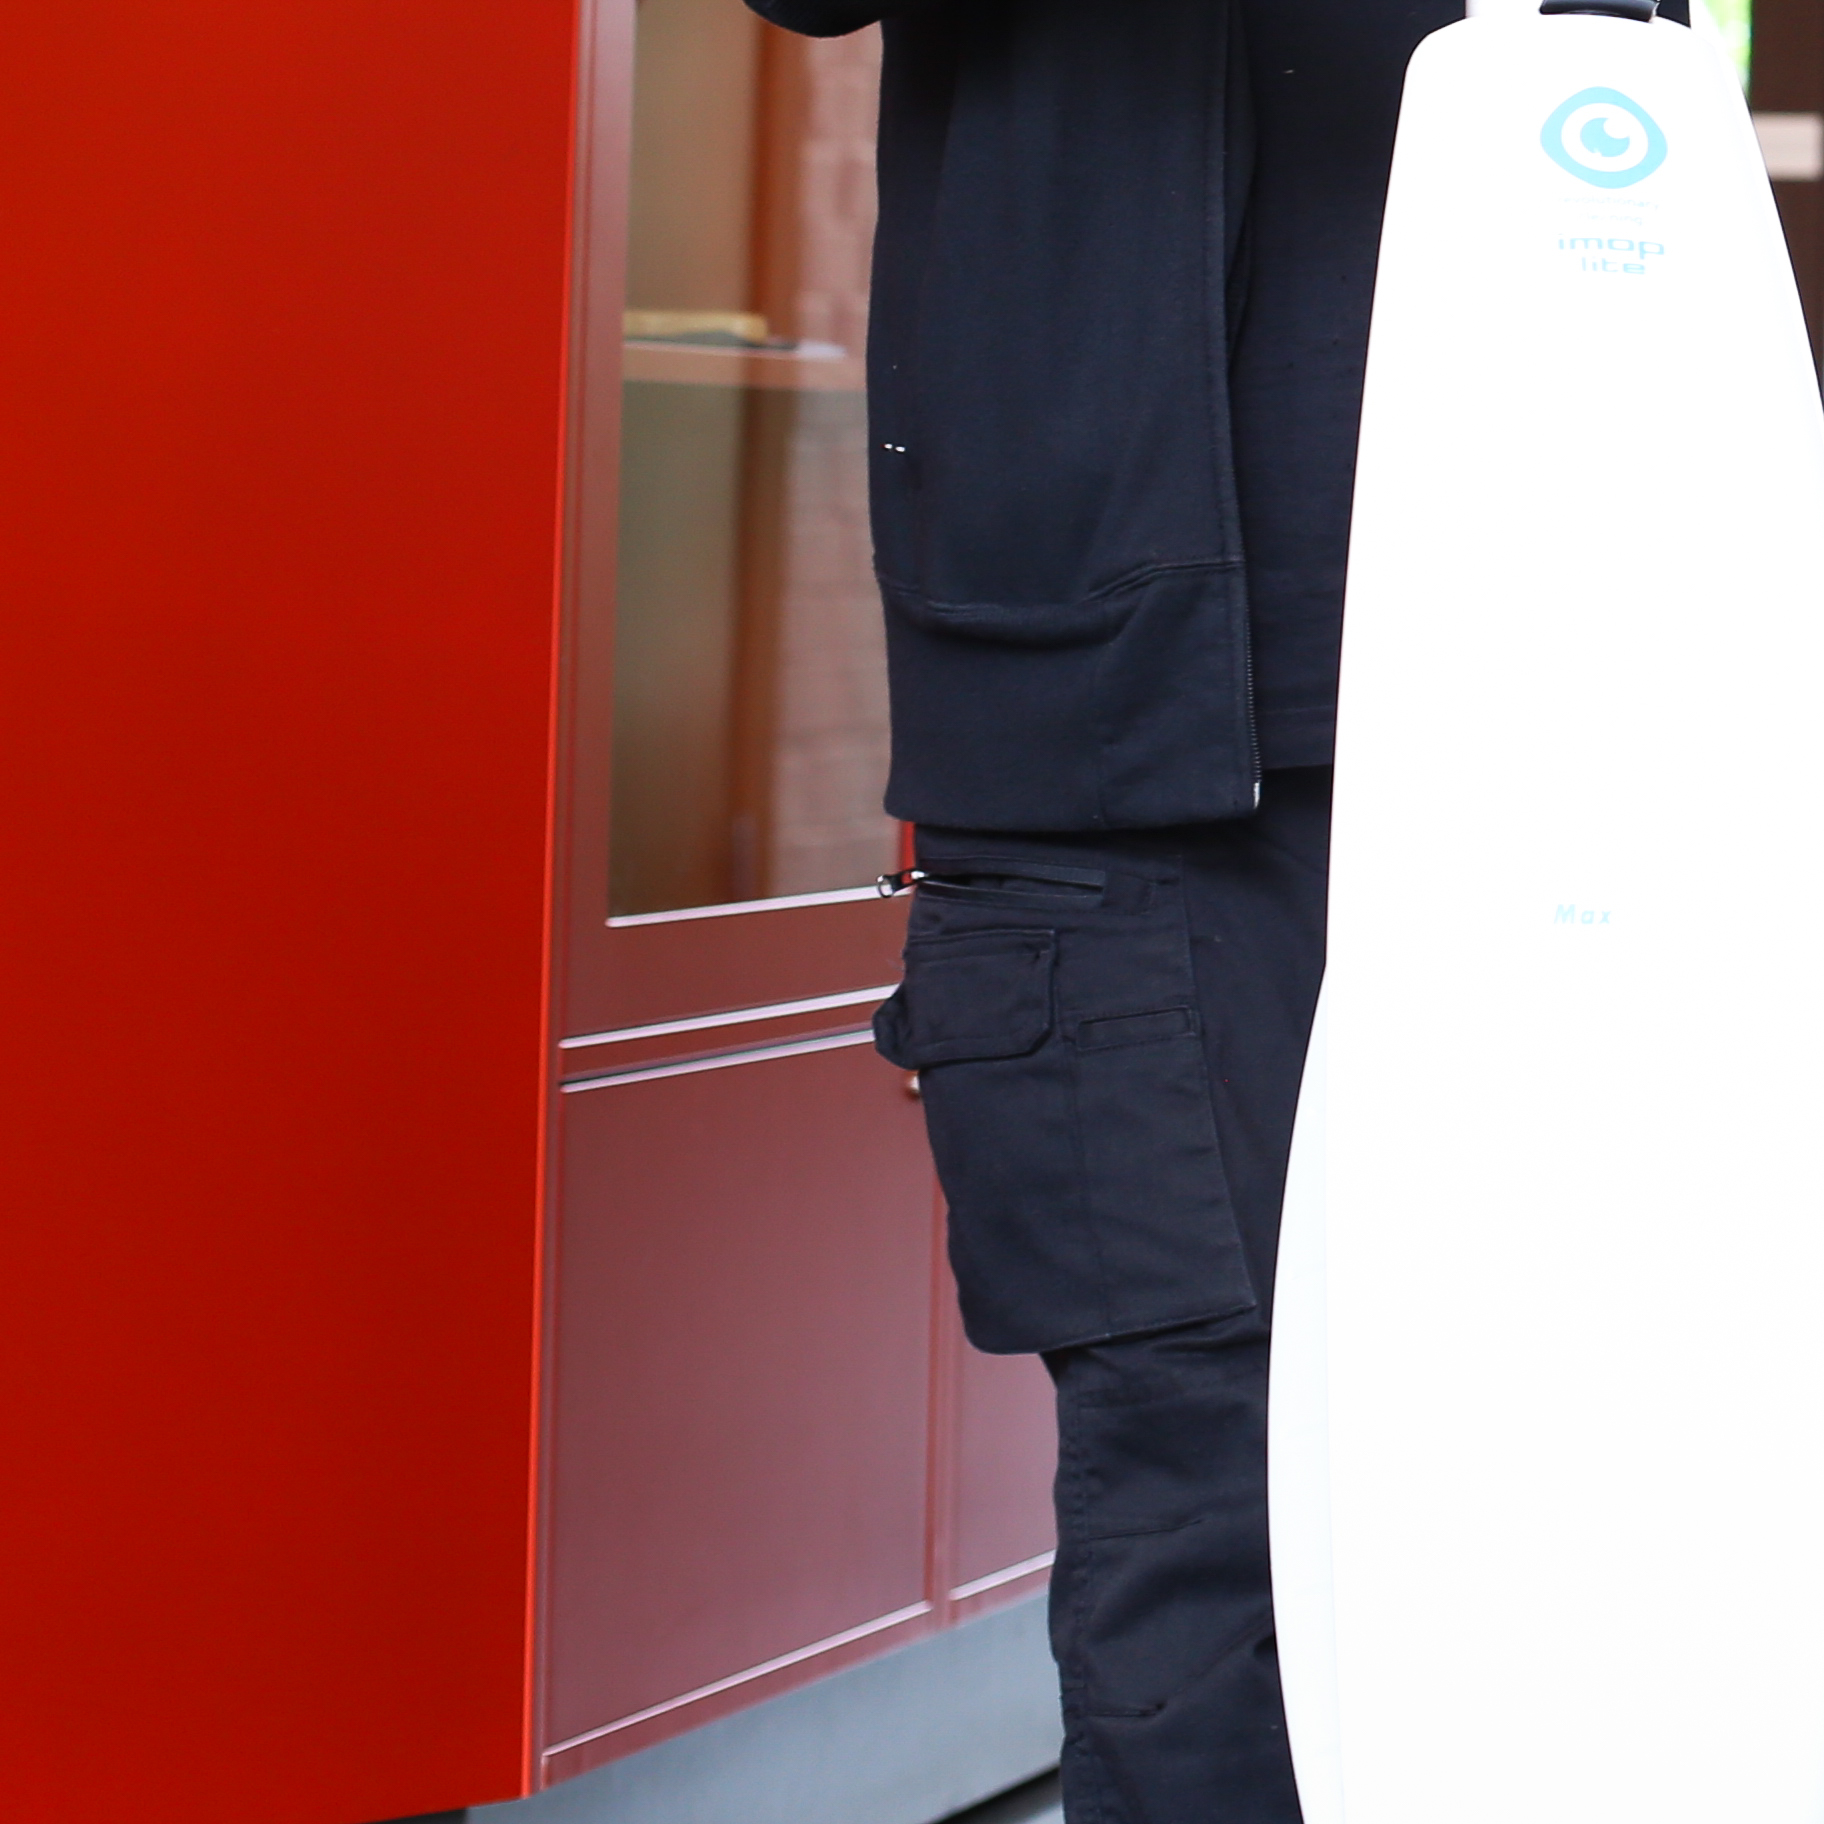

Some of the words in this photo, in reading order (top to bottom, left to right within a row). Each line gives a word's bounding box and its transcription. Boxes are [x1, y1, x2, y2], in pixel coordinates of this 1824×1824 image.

[1557, 233, 1665, 260] imop
[1581, 256, 1646, 275] lite
[1553, 904, 1612, 925] Max
